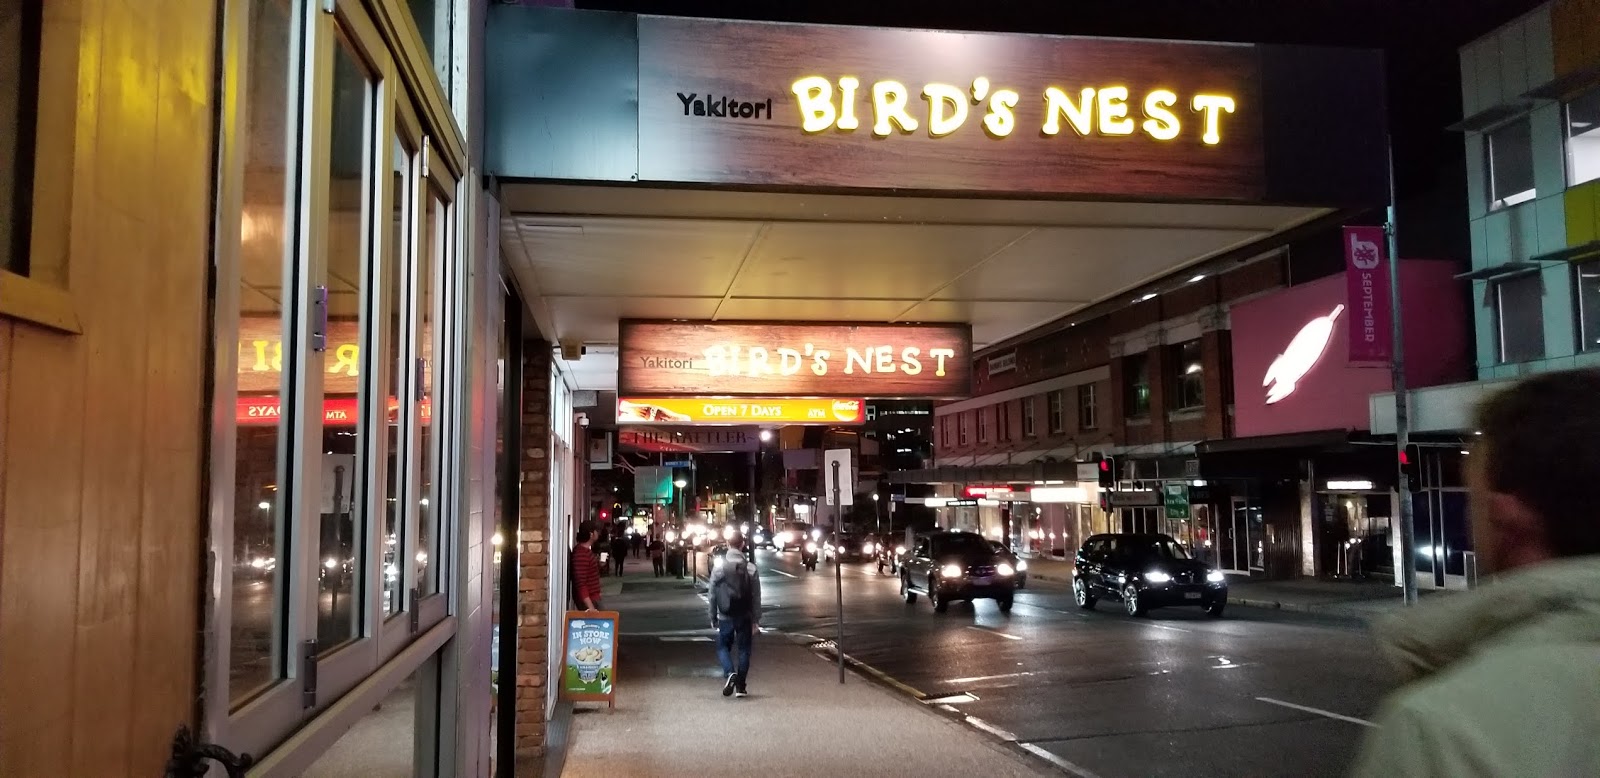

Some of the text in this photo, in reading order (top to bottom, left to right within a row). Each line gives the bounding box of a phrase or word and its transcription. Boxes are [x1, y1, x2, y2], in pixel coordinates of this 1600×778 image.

[676, 74, 1236, 146] Yakitori BIRD'S NEST
[1361, 272, 1376, 343] SEPTEMBER
[640, 355, 693, 370] Yakitori
[703, 343, 831, 377] BIRD'S
[843, 345, 955, 377] NEST
[703, 405, 782, 417] OPEN 7 DAYS
[807, 409, 826, 418] ATM
[669, 431, 747, 443] RATTLER
[572, 630, 610, 640] IN STORE
[580, 637, 602, 645] NOW
